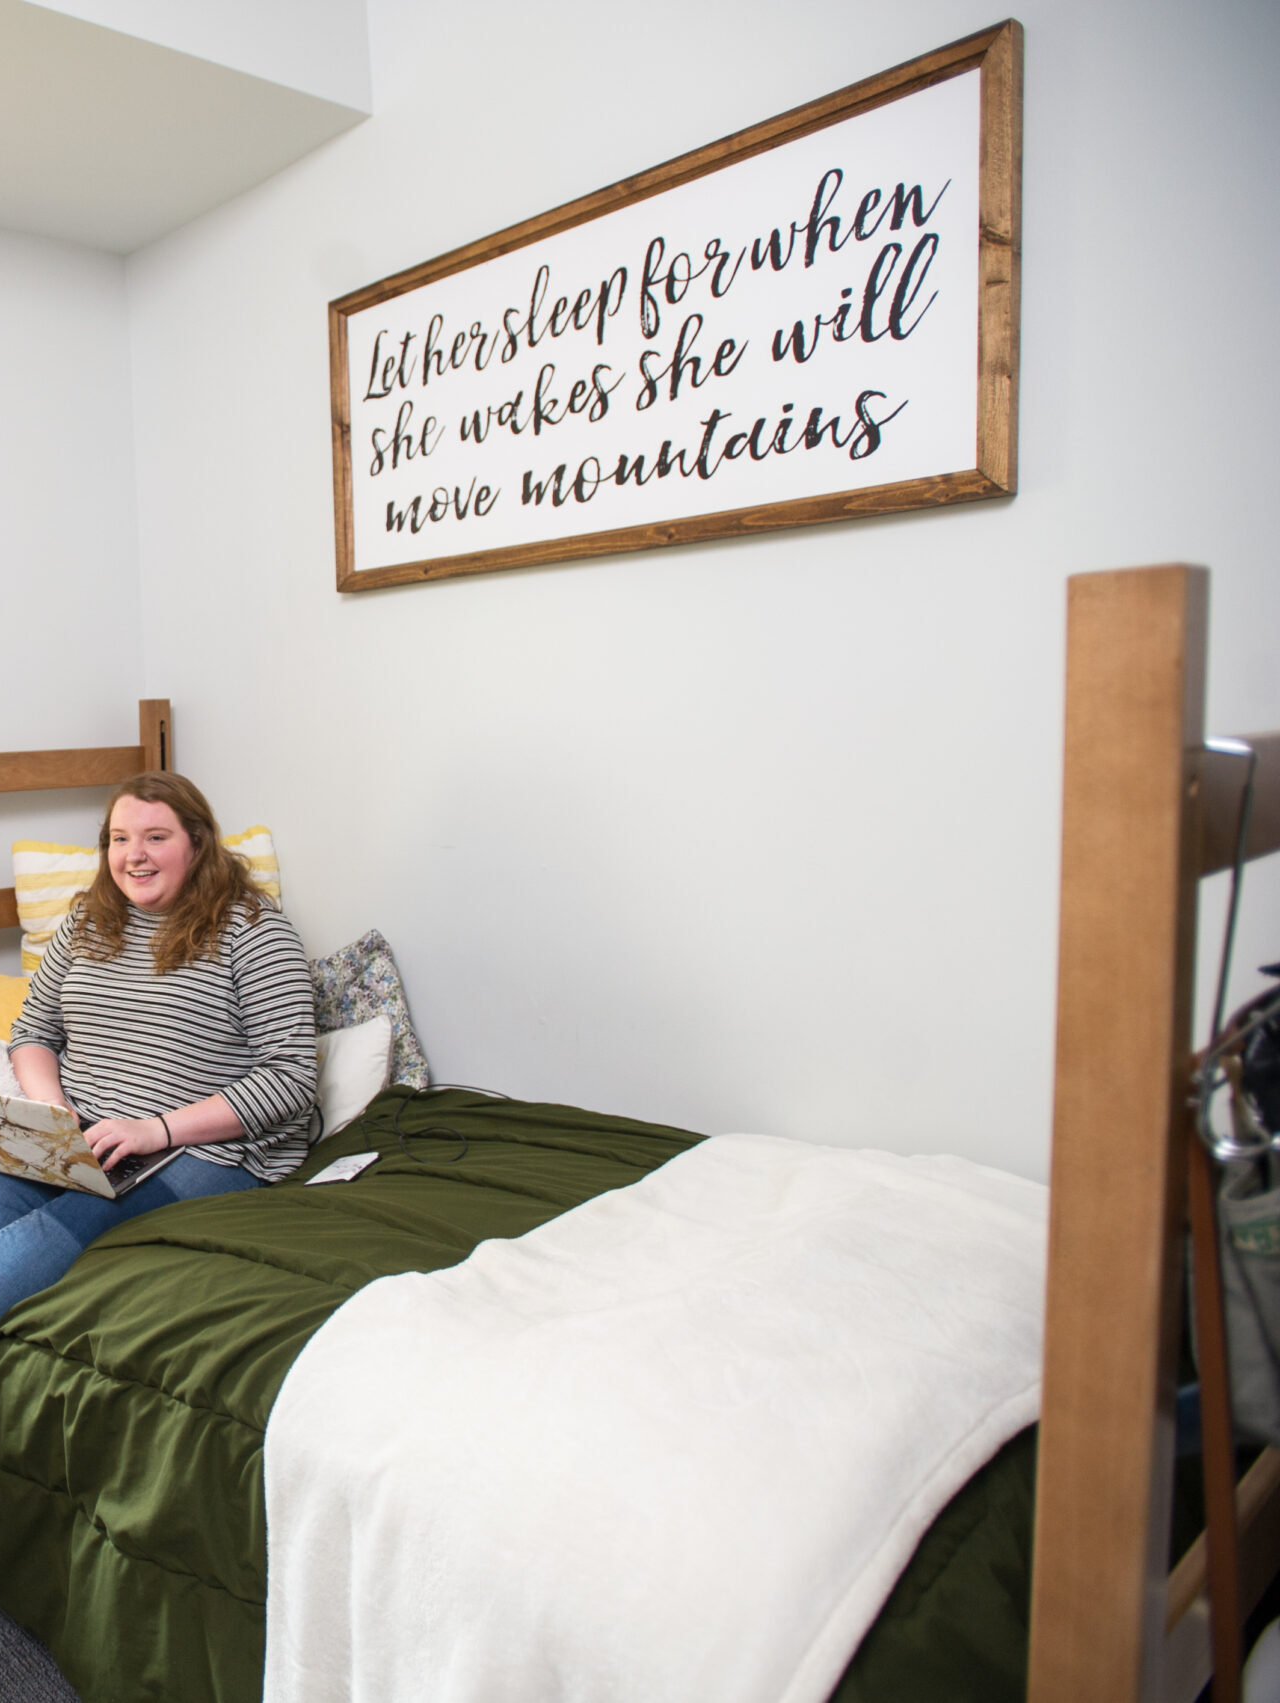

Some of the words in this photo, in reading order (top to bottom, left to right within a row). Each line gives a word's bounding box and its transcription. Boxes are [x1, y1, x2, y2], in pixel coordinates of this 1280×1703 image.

[363, 330, 418, 402] Let
[422, 314, 500, 386] her
[501, 264, 628, 363] sleep
[640, 236, 747, 340] for
[750, 168, 952, 272] when
[370, 400, 445, 477] she
[459, 363, 627, 444] wakes
[635, 313, 749, 412] she
[771, 232, 940, 364] will
[384, 477, 501, 535] move
[521, 389, 909, 508] mountains
